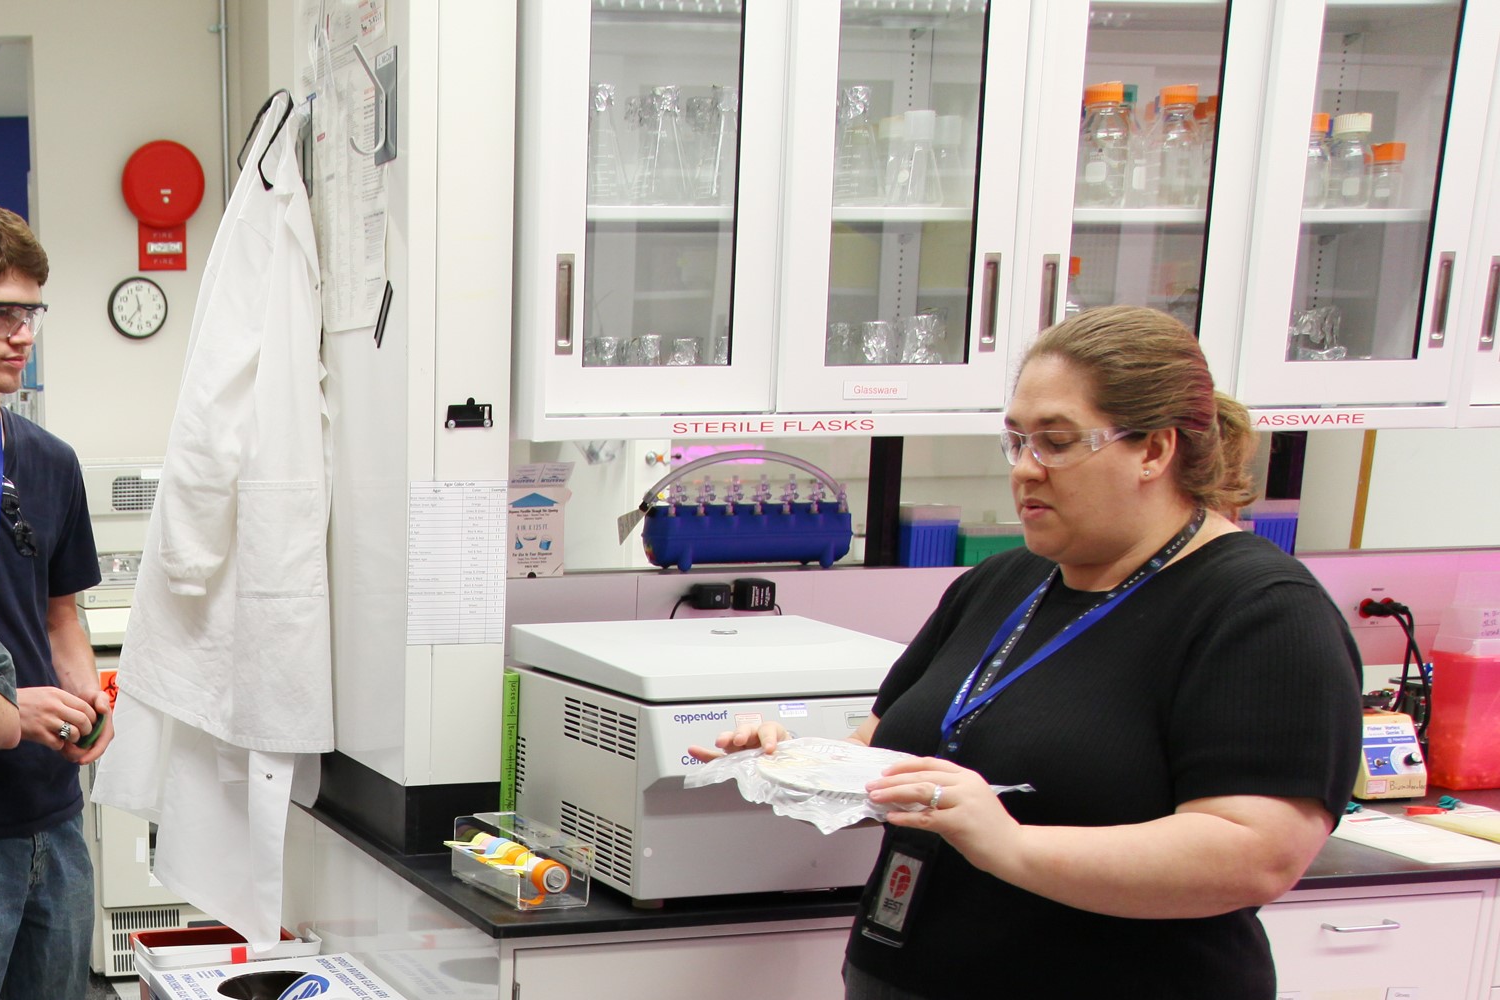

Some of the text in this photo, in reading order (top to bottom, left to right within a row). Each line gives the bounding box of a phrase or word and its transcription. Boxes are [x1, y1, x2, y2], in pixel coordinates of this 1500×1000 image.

[853, 384, 898, 395] Glassware
[1251, 413, 1365, 426] ASSWARE
[673, 419, 875, 434] STERILE FLASKS
[674, 710, 728, 724] eppendorf
